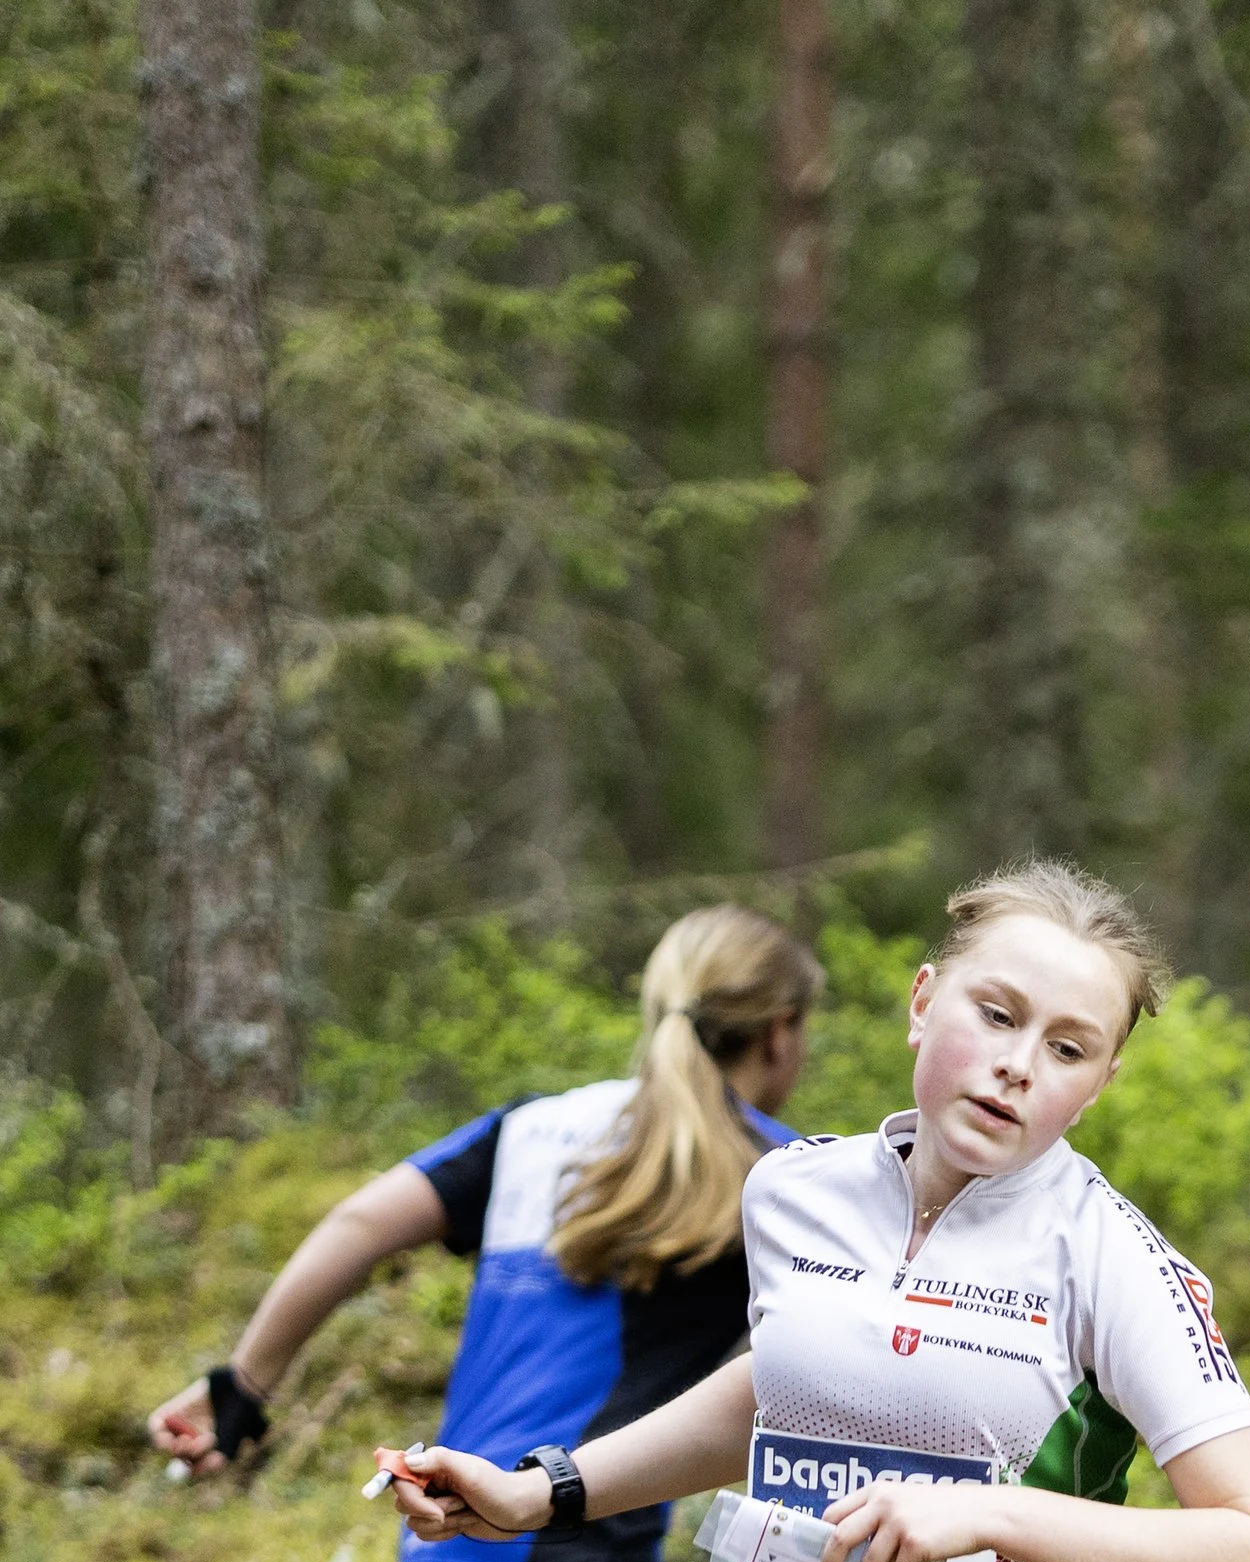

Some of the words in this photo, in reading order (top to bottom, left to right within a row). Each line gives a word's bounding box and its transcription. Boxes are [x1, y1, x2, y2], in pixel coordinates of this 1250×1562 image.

[791, 1256, 865, 1283] TRIMTEX
[912, 1277, 1019, 1307] TULLINGE
[1022, 1293, 1051, 1313] SK
[954, 1300, 1028, 1322] BOTKYRKA
[1159, 1266, 1187, 1314] BIKE
[1186, 1326, 1213, 1384] RACE
[923, 1334, 983, 1354] BOTKYRKA
[986, 1345, 1043, 1366] KOMMUN
[763, 1446, 983, 1501] bagh
